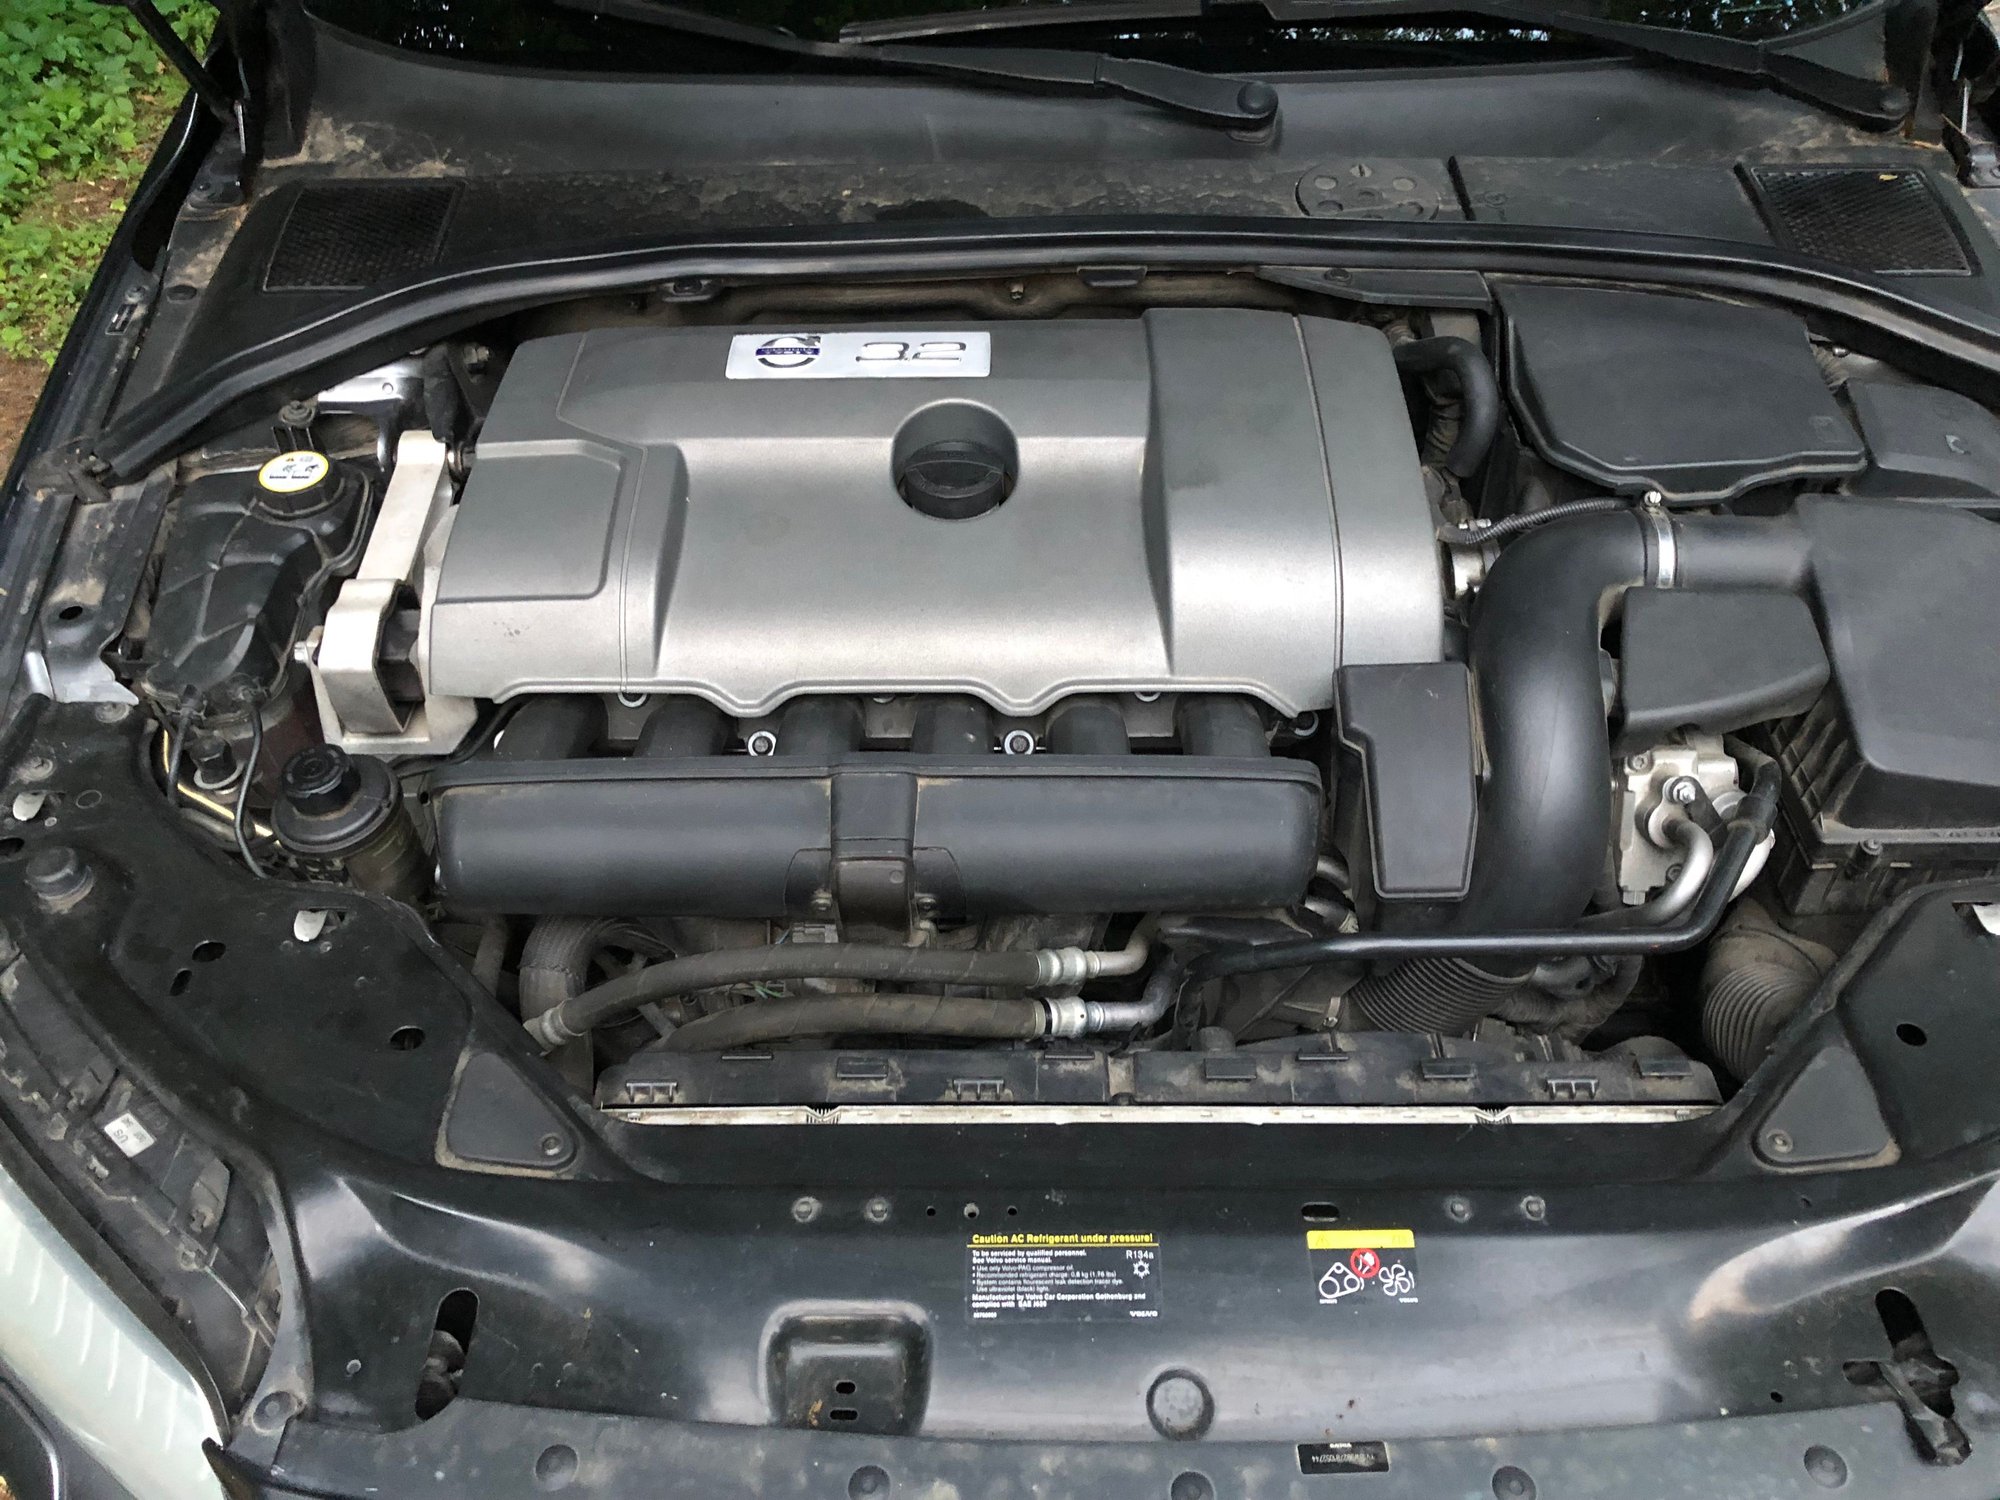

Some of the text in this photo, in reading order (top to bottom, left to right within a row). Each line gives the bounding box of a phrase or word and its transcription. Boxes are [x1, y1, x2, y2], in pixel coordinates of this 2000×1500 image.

[855, 341, 967, 362] 3.2
[972, 1234, 1153, 1244] Caution AC Refrigerant under pressure!
[1017, 1249, 1025, 1257] by
[1026, 1249, 1053, 1257] qualified
[1126, 1249, 1154, 1260] R134a
[989, 1264, 1000, 1272] only
[1032, 1264, 1065, 1272] compressor
[1019, 1271, 1047, 1279] refrigerant
[1081, 1271, 1089, 1279] kg
[976, 1279, 997, 1287] System
[971, 1293, 1146, 1302] Manufactured by Volvo Car Corporation Gothenburg and
[971, 1301, 1000, 1309] complies
